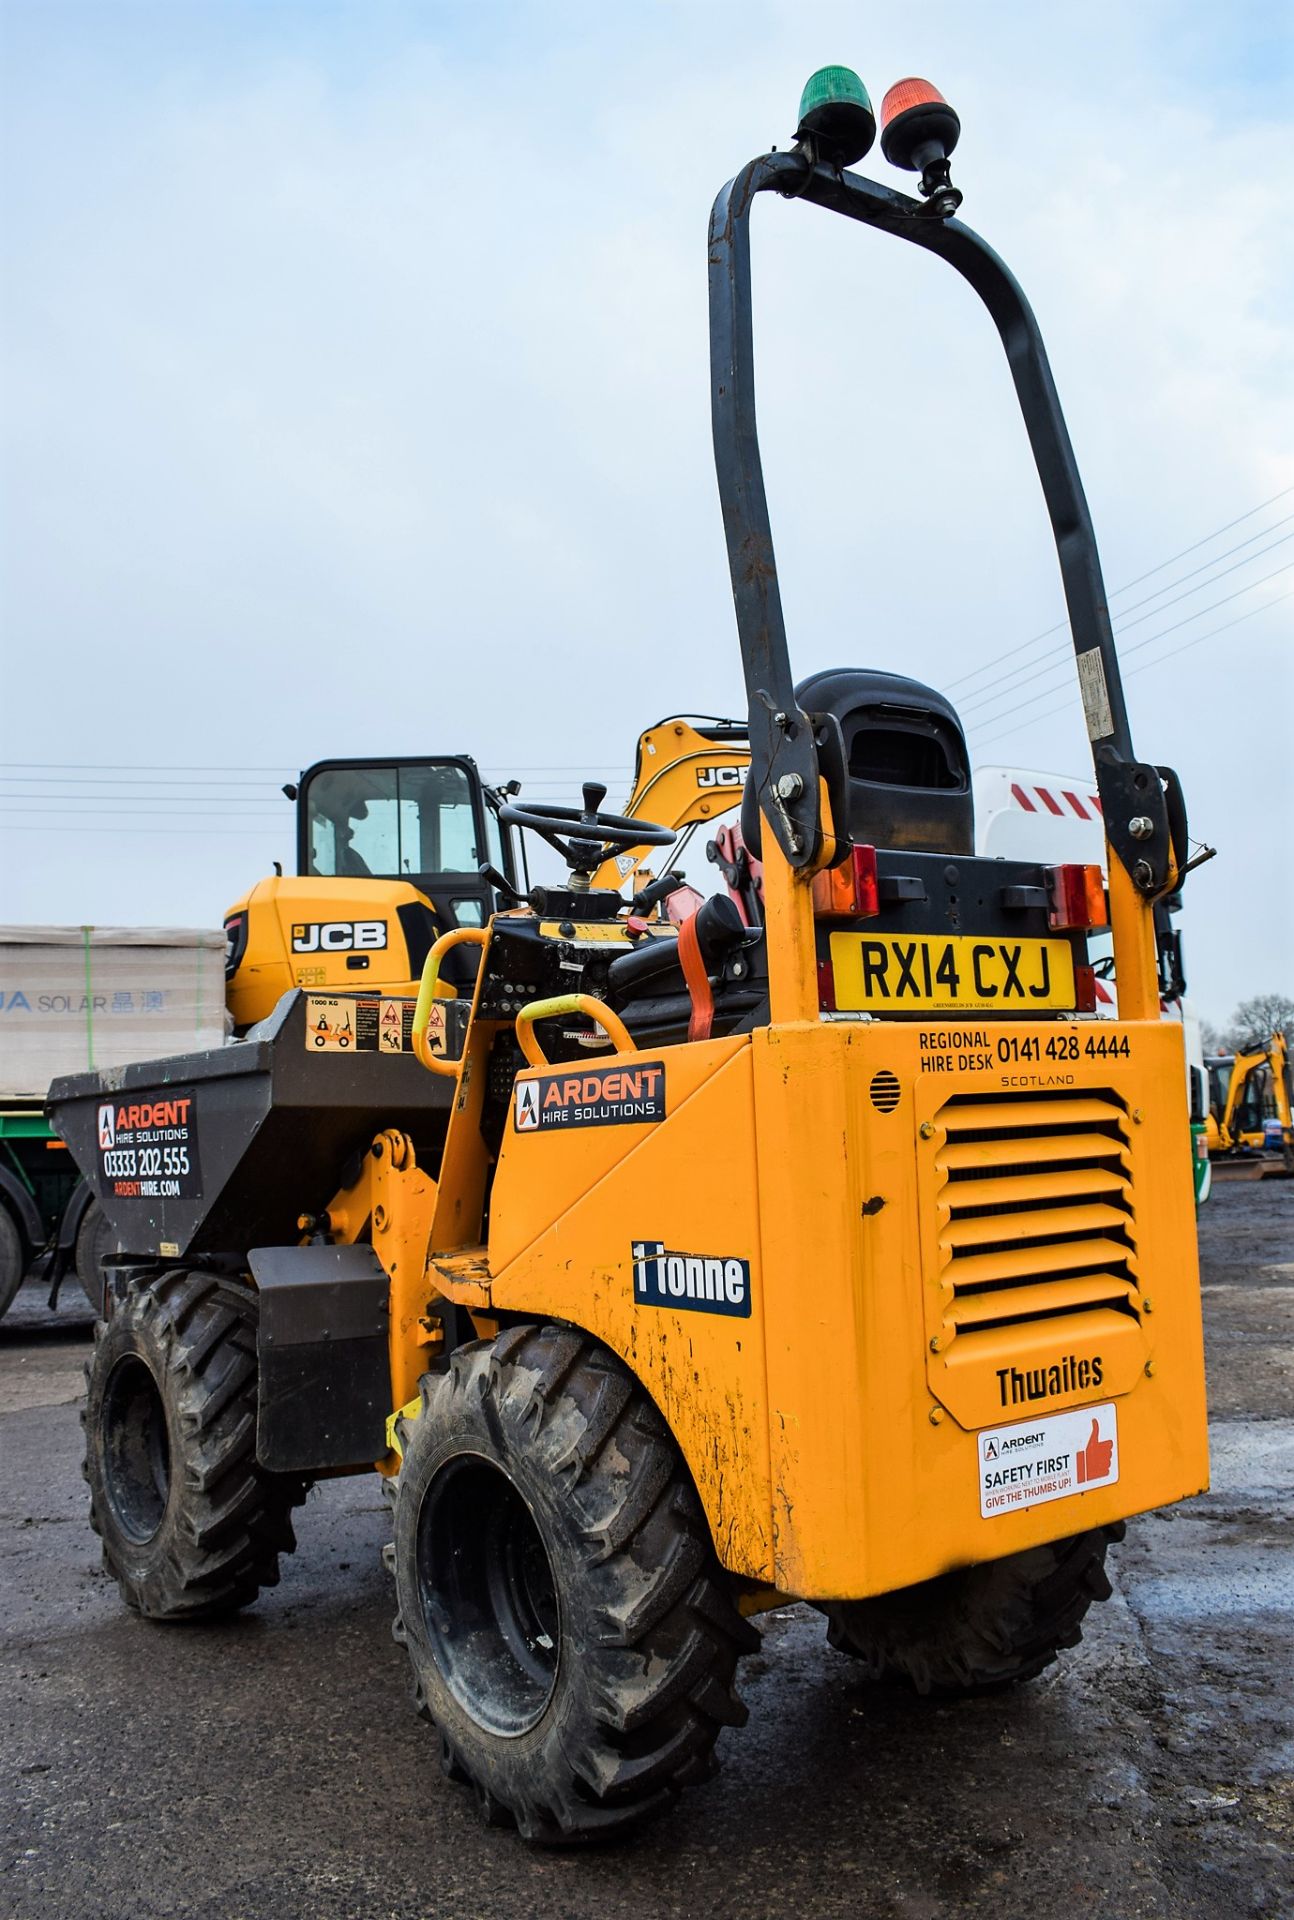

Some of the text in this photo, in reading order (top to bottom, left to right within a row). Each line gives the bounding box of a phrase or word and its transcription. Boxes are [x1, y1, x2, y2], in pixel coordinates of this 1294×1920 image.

[293, 922, 386, 952] JCB
[861, 941, 1050, 998] RX14 CXJ
[38, 995, 107, 1013] SOLAR
[920, 1031, 991, 1049] REGIONAL
[997, 1035, 1131, 1062] 0141 428 4444
[921, 1054, 994, 1072] HIRE DESK
[543, 1069, 661, 1108] ARDENT
[1001, 1075, 1074, 1087] SCOTLAND
[116, 1099, 191, 1130] ARDENT
[542, 1102, 656, 1123] HIRE SOLUTIONS
[116, 1128, 189, 1144] HIRE SOLUTIONS
[104, 1146, 190, 1177] 03333 202 555
[114, 1180, 180, 1196] ARDENTHIRE.COM
[656, 1244, 745, 1304] tonne
[996, 1355, 1104, 1407] Thwaites
[1001, 1432, 1045, 1451] ARDENT
[985, 1454, 1070, 1489] SAFETY FIRST
[985, 1477, 1072, 1509] GIVE THE THUMBS UP!
